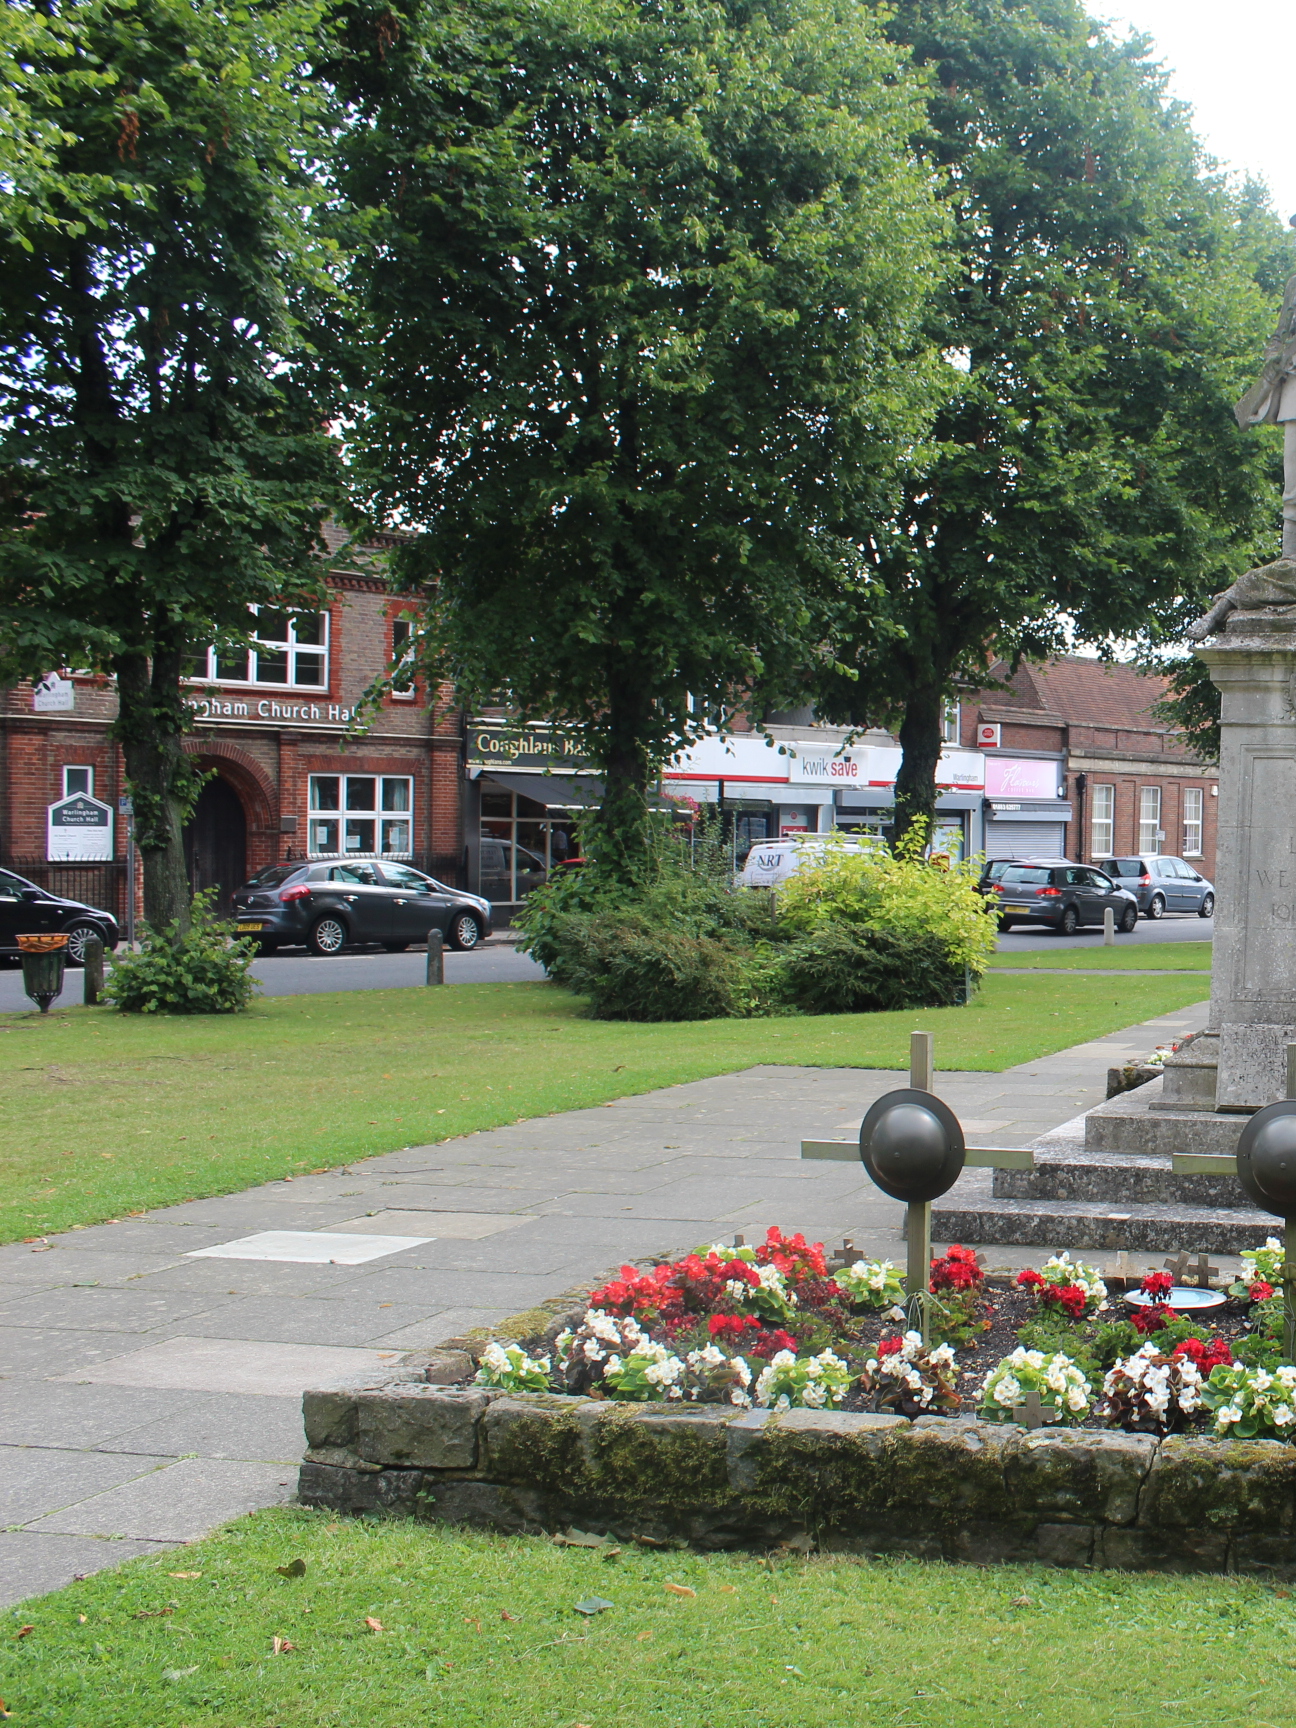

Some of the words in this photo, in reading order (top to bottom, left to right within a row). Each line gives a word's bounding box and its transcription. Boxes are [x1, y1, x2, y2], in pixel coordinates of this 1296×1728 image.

[257, 700, 320, 719] Church
[328, 704, 360, 722] Hal
[802, 757, 829, 776] kwik
[831, 762, 858, 777] save
[952, 773, 979, 783] Warlingham
[757, 854, 784, 867] NRT
[1256, 869, 1290, 888] WE
